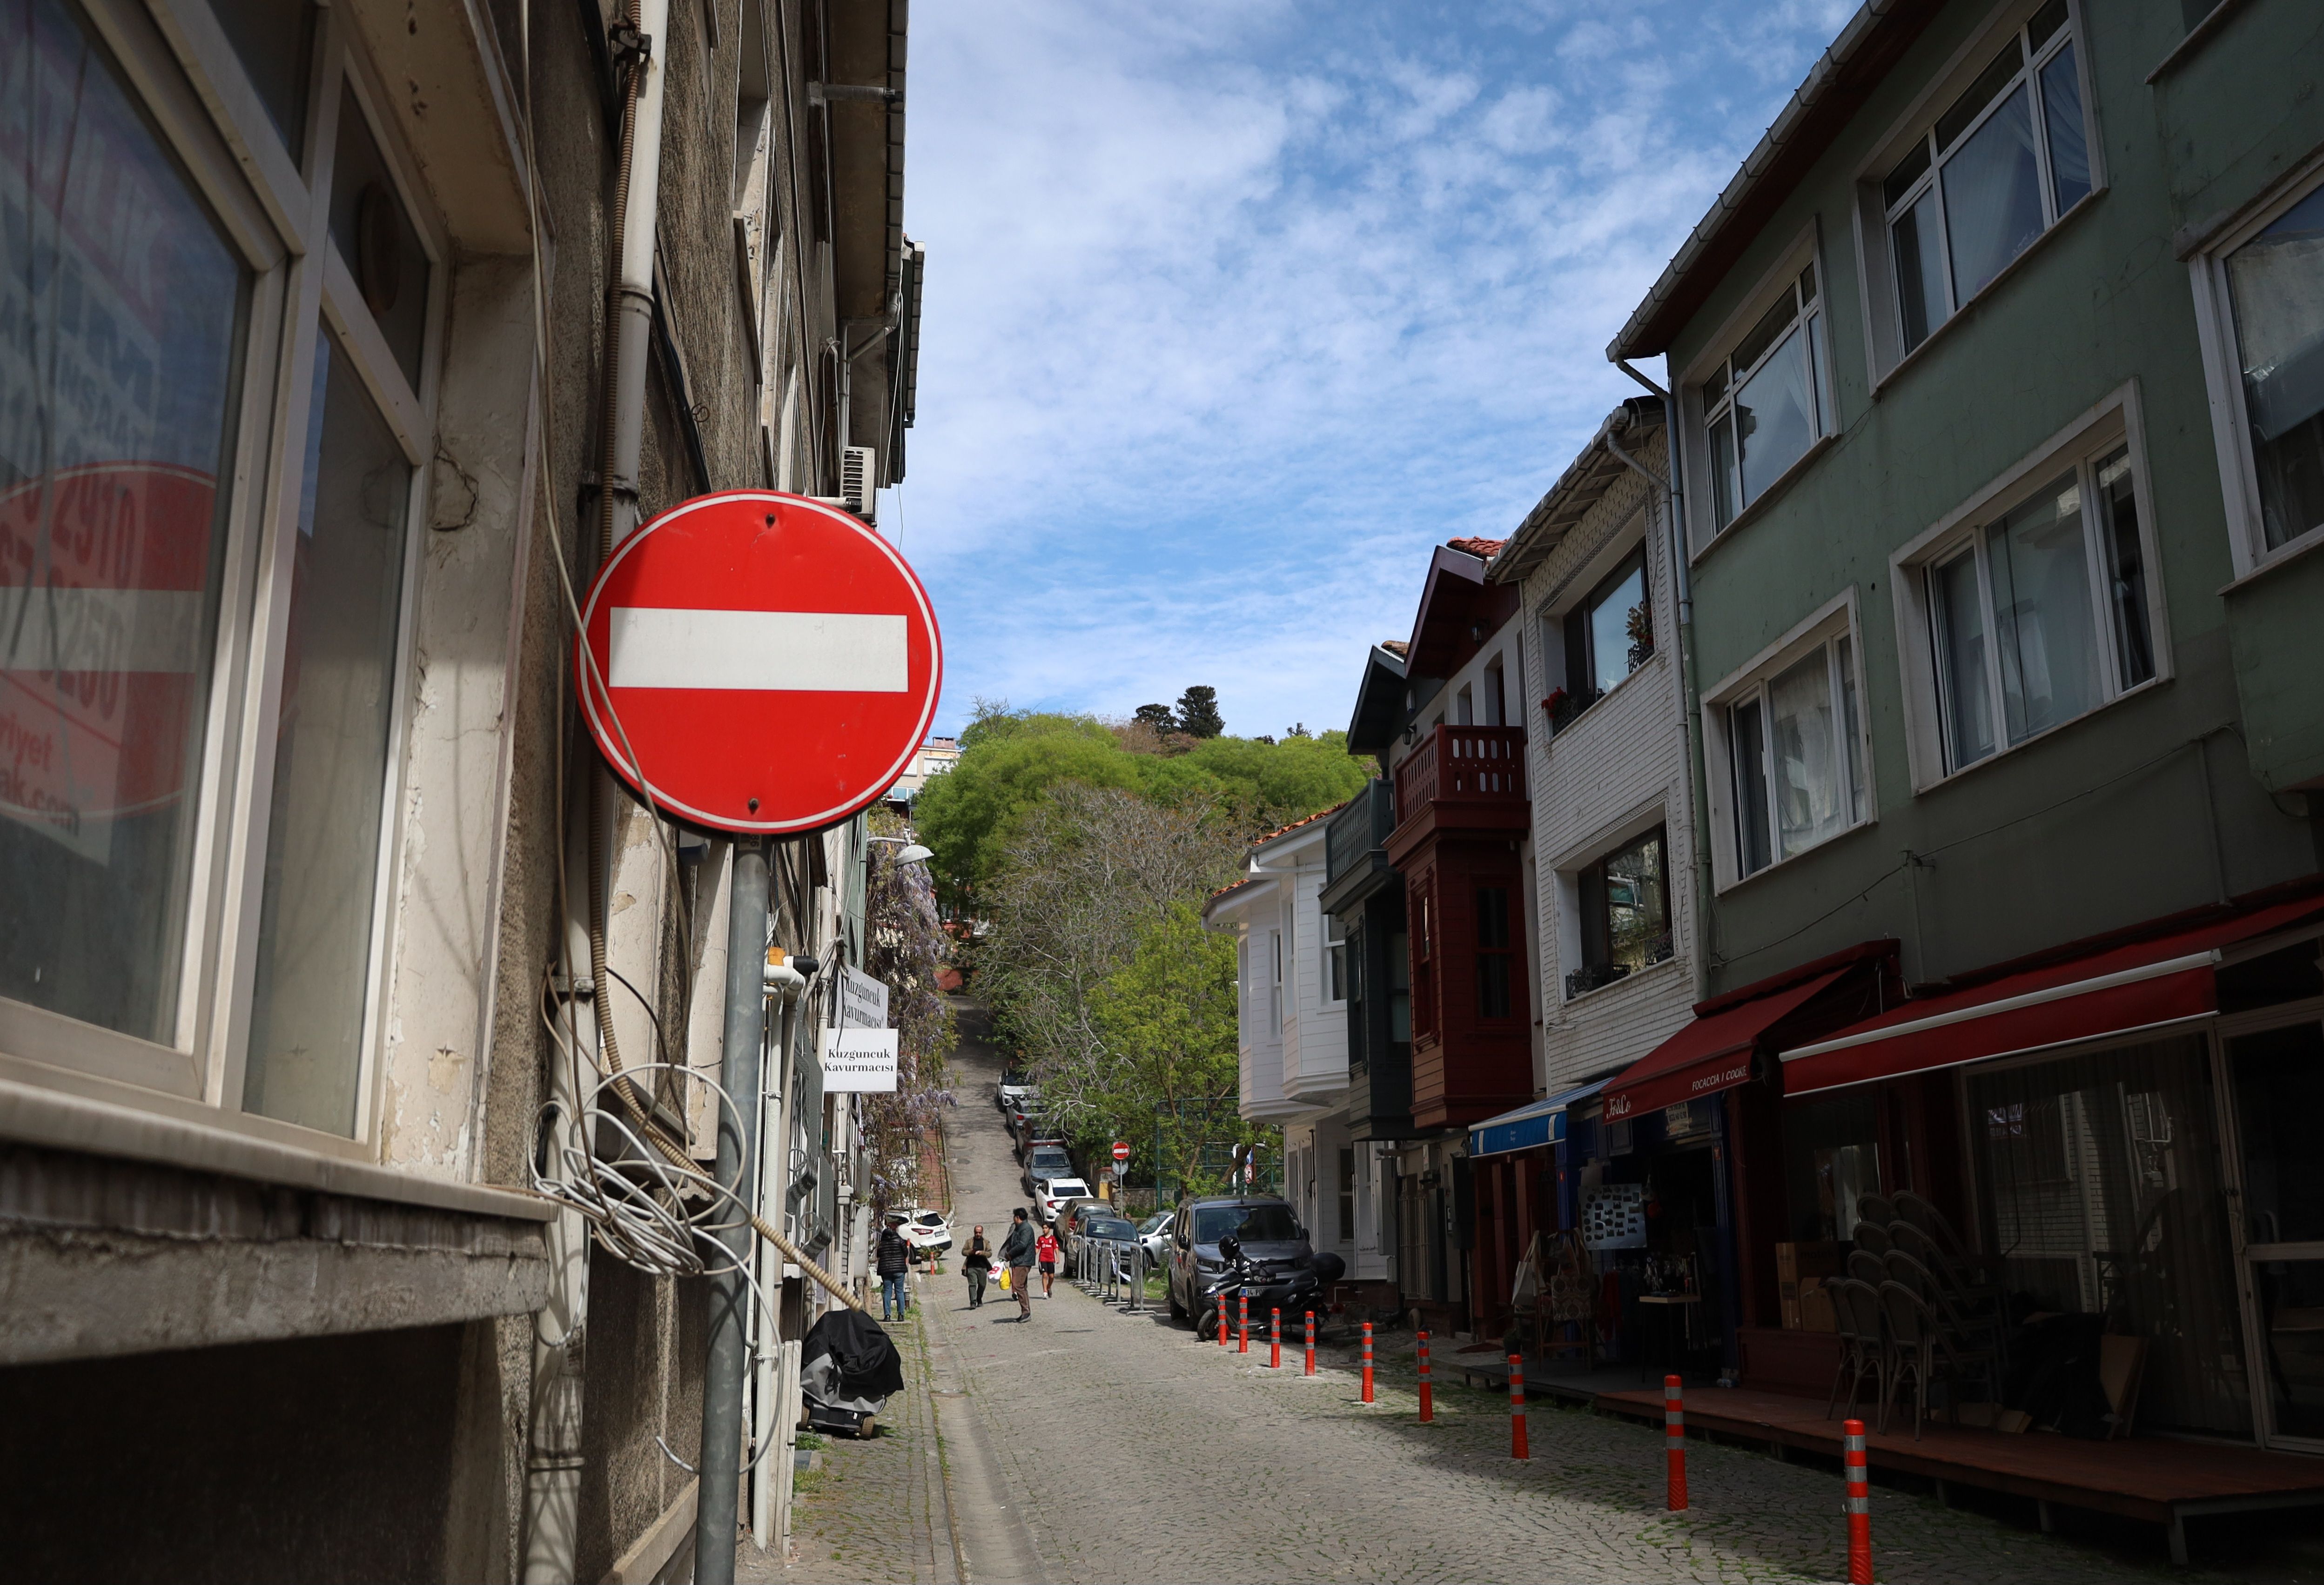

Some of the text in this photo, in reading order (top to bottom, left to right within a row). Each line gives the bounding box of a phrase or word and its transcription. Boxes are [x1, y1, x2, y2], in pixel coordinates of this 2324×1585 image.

[828, 1048, 891, 1061] Kuzguncuk
[825, 1062, 893, 1072] Kavurmacısı
[1692, 1074, 1719, 1091] FOCACCIA
[1726, 1065, 1747, 1081] COOKIE
